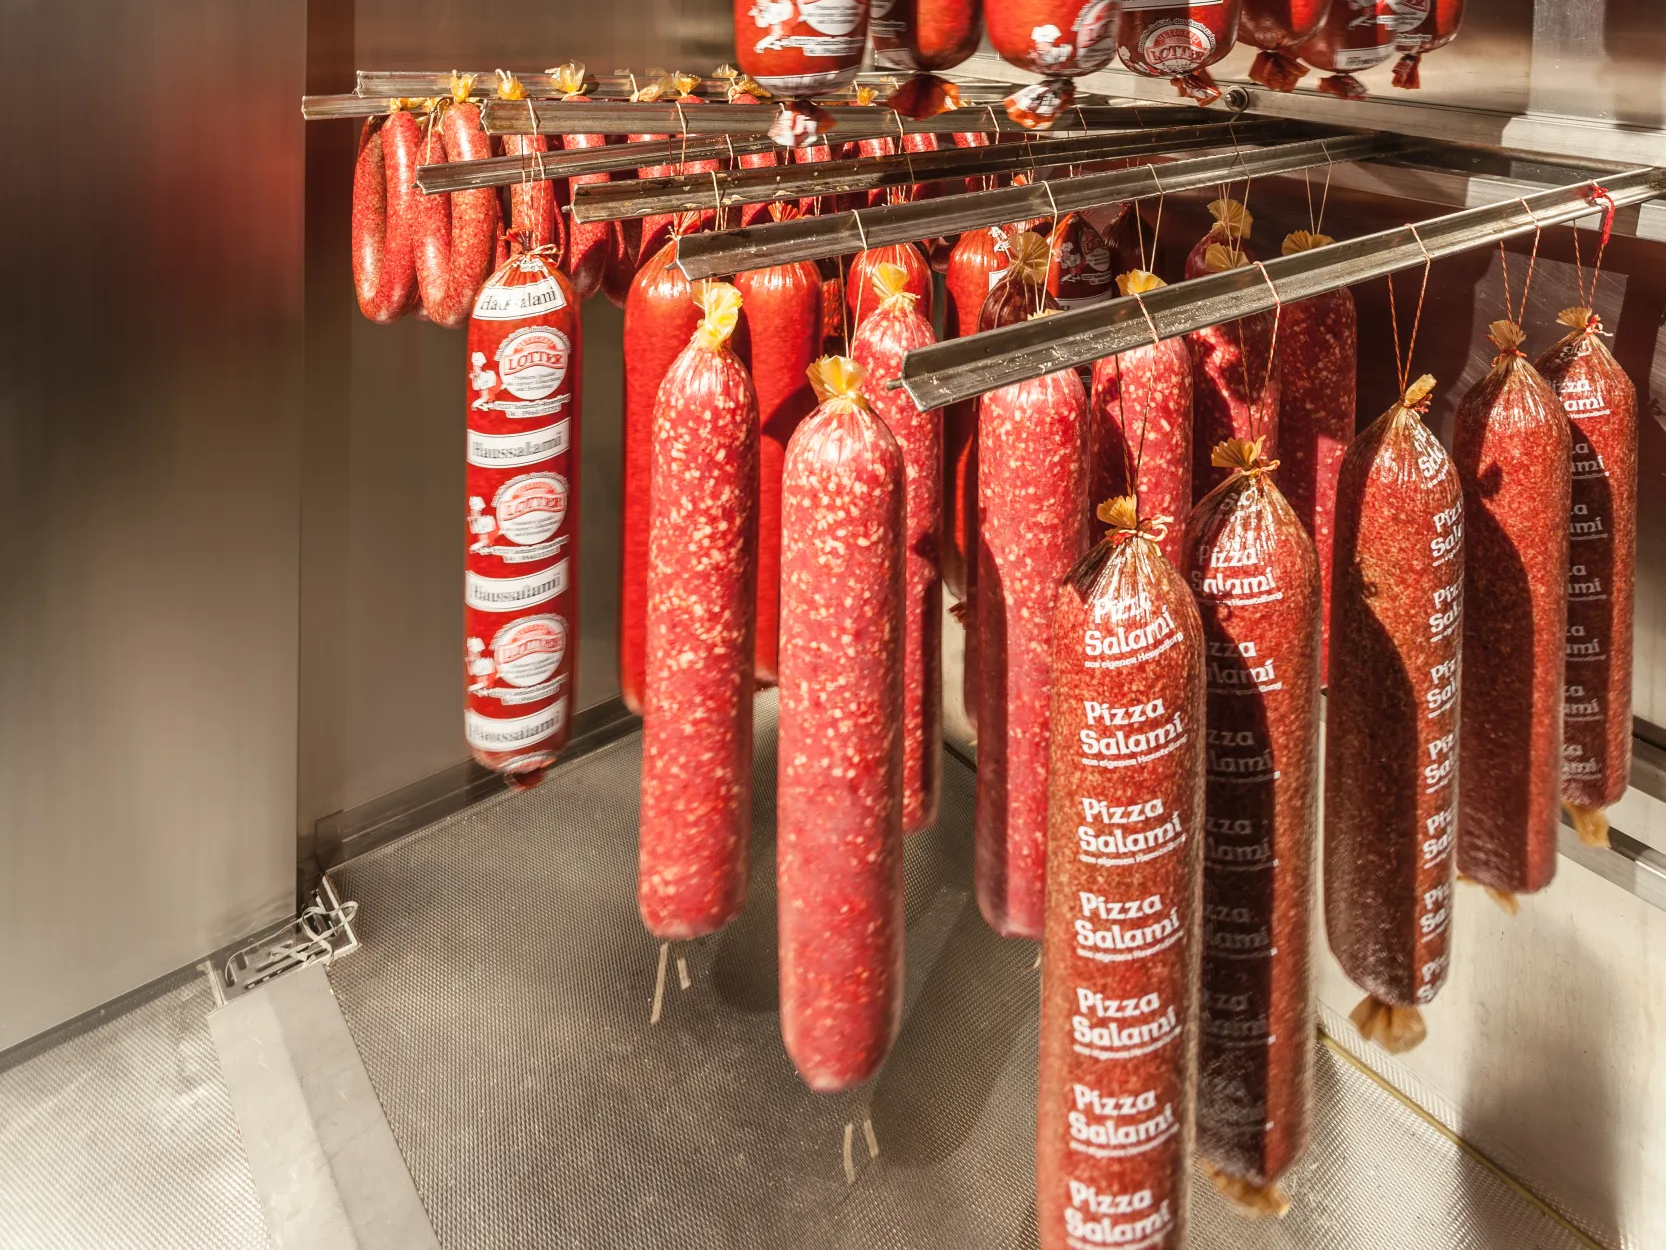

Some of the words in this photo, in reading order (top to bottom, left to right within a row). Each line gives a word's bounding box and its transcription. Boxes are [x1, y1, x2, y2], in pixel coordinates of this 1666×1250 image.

[1084, 604, 1175, 657] Salami
[1083, 698, 1165, 726] Pizza
[1080, 711, 1183, 757] Salami
[1078, 810, 1182, 854] Salami
[1082, 798, 1164, 824] Pizza
[1079, 891, 1163, 920] Pizza
[1075, 906, 1180, 950] Salami
[1077, 987, 1160, 1018] Pizza
[1072, 1004, 1177, 1047] Salami
[1073, 1083, 1157, 1117] Pizza
[1068, 1102, 1175, 1146] Salami
[1068, 1179, 1152, 1214] Pizza
[1064, 1199, 1172, 1243] Salami
